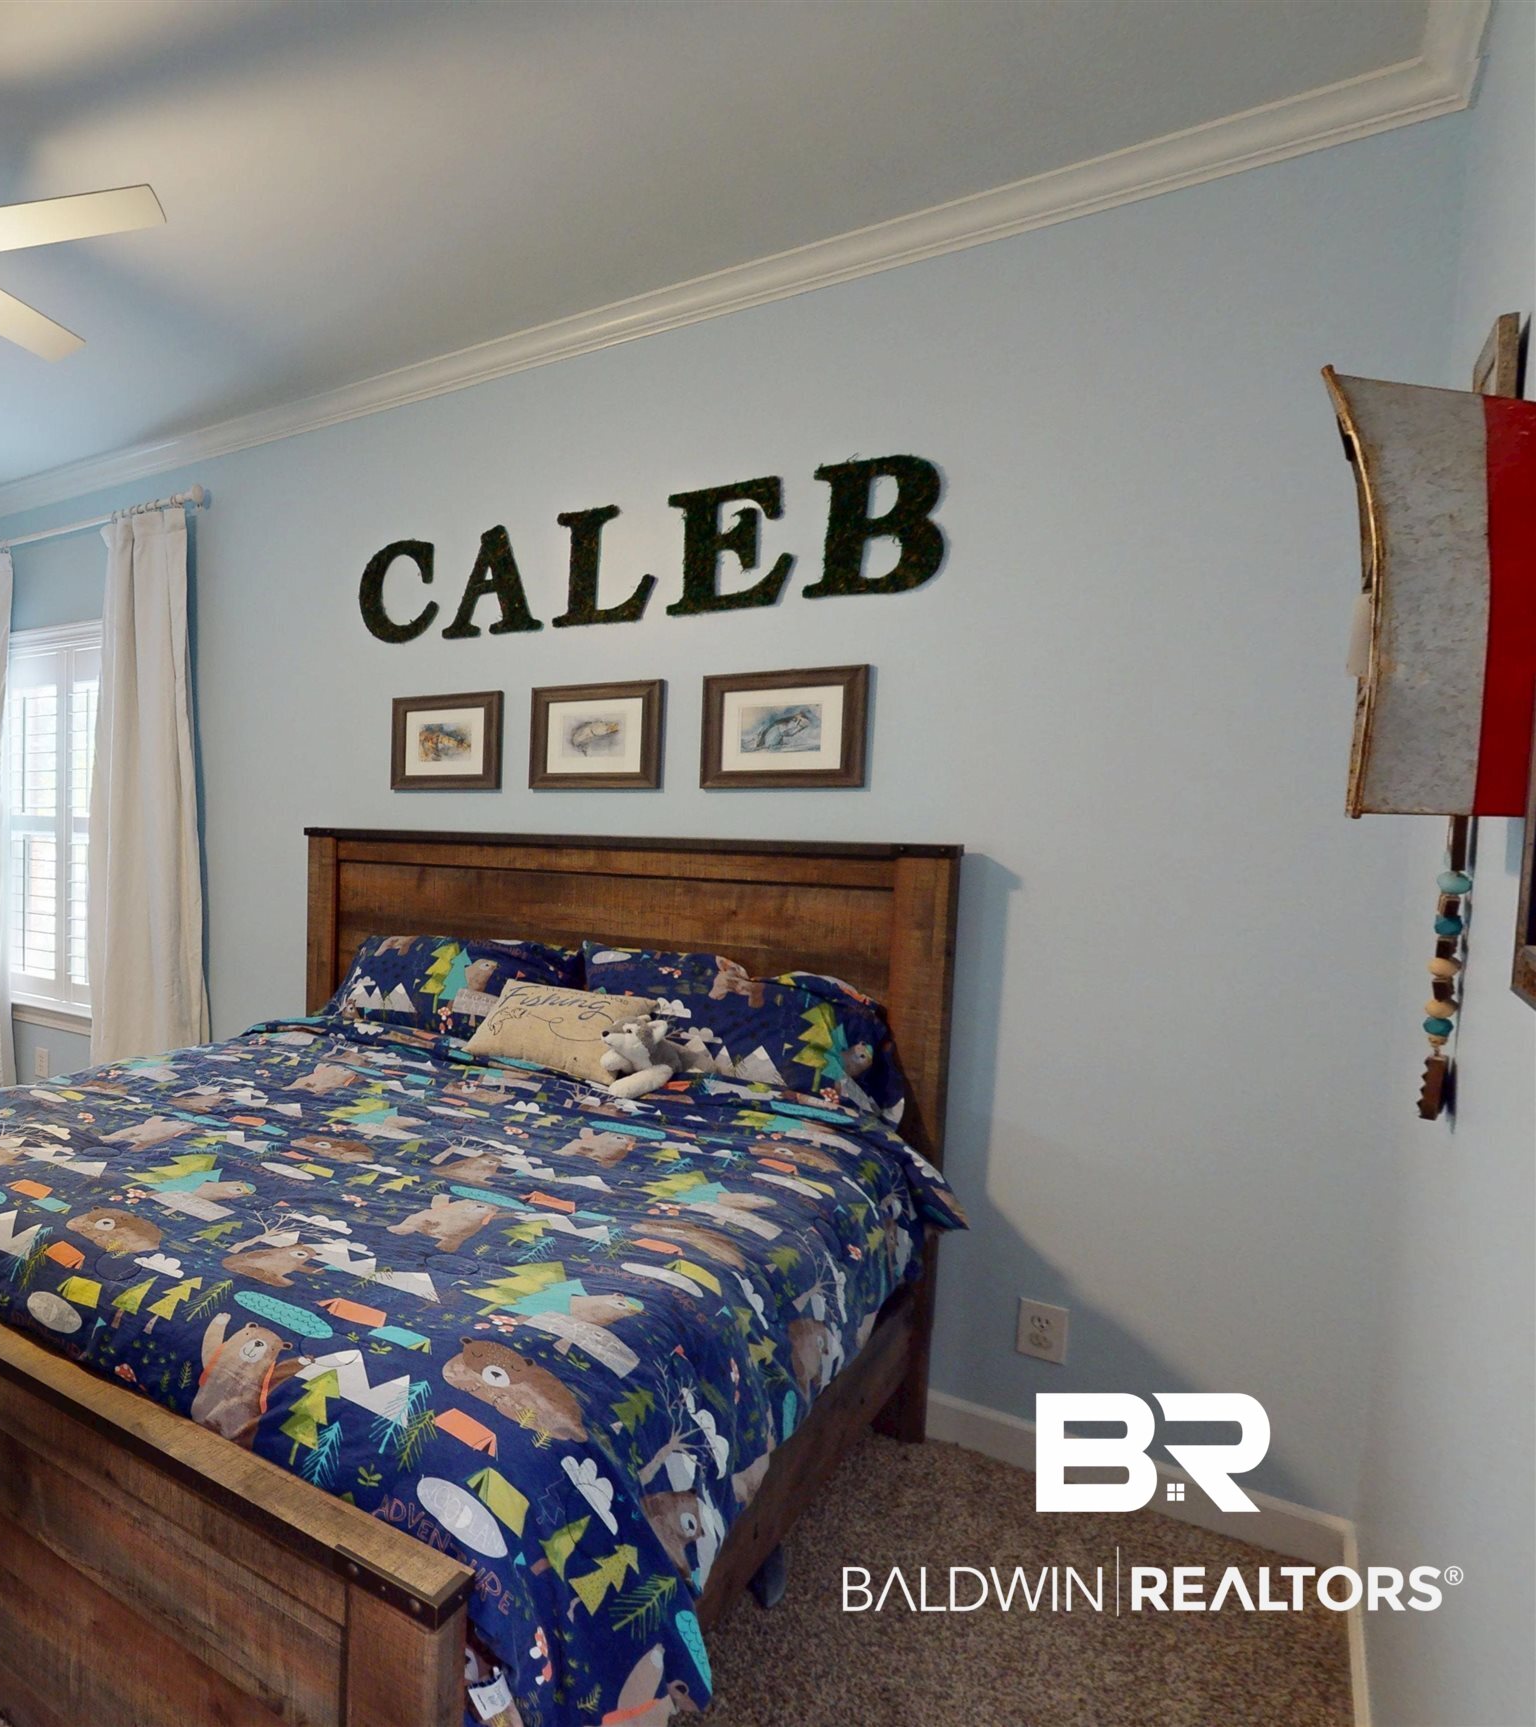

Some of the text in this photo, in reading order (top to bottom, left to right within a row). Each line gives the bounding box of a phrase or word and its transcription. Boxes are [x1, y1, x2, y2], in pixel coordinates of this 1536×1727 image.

[359, 453, 946, 644] CALEB
[498, 986, 615, 1025] Fishing
[372, 1494, 515, 1616] ADVENRE
